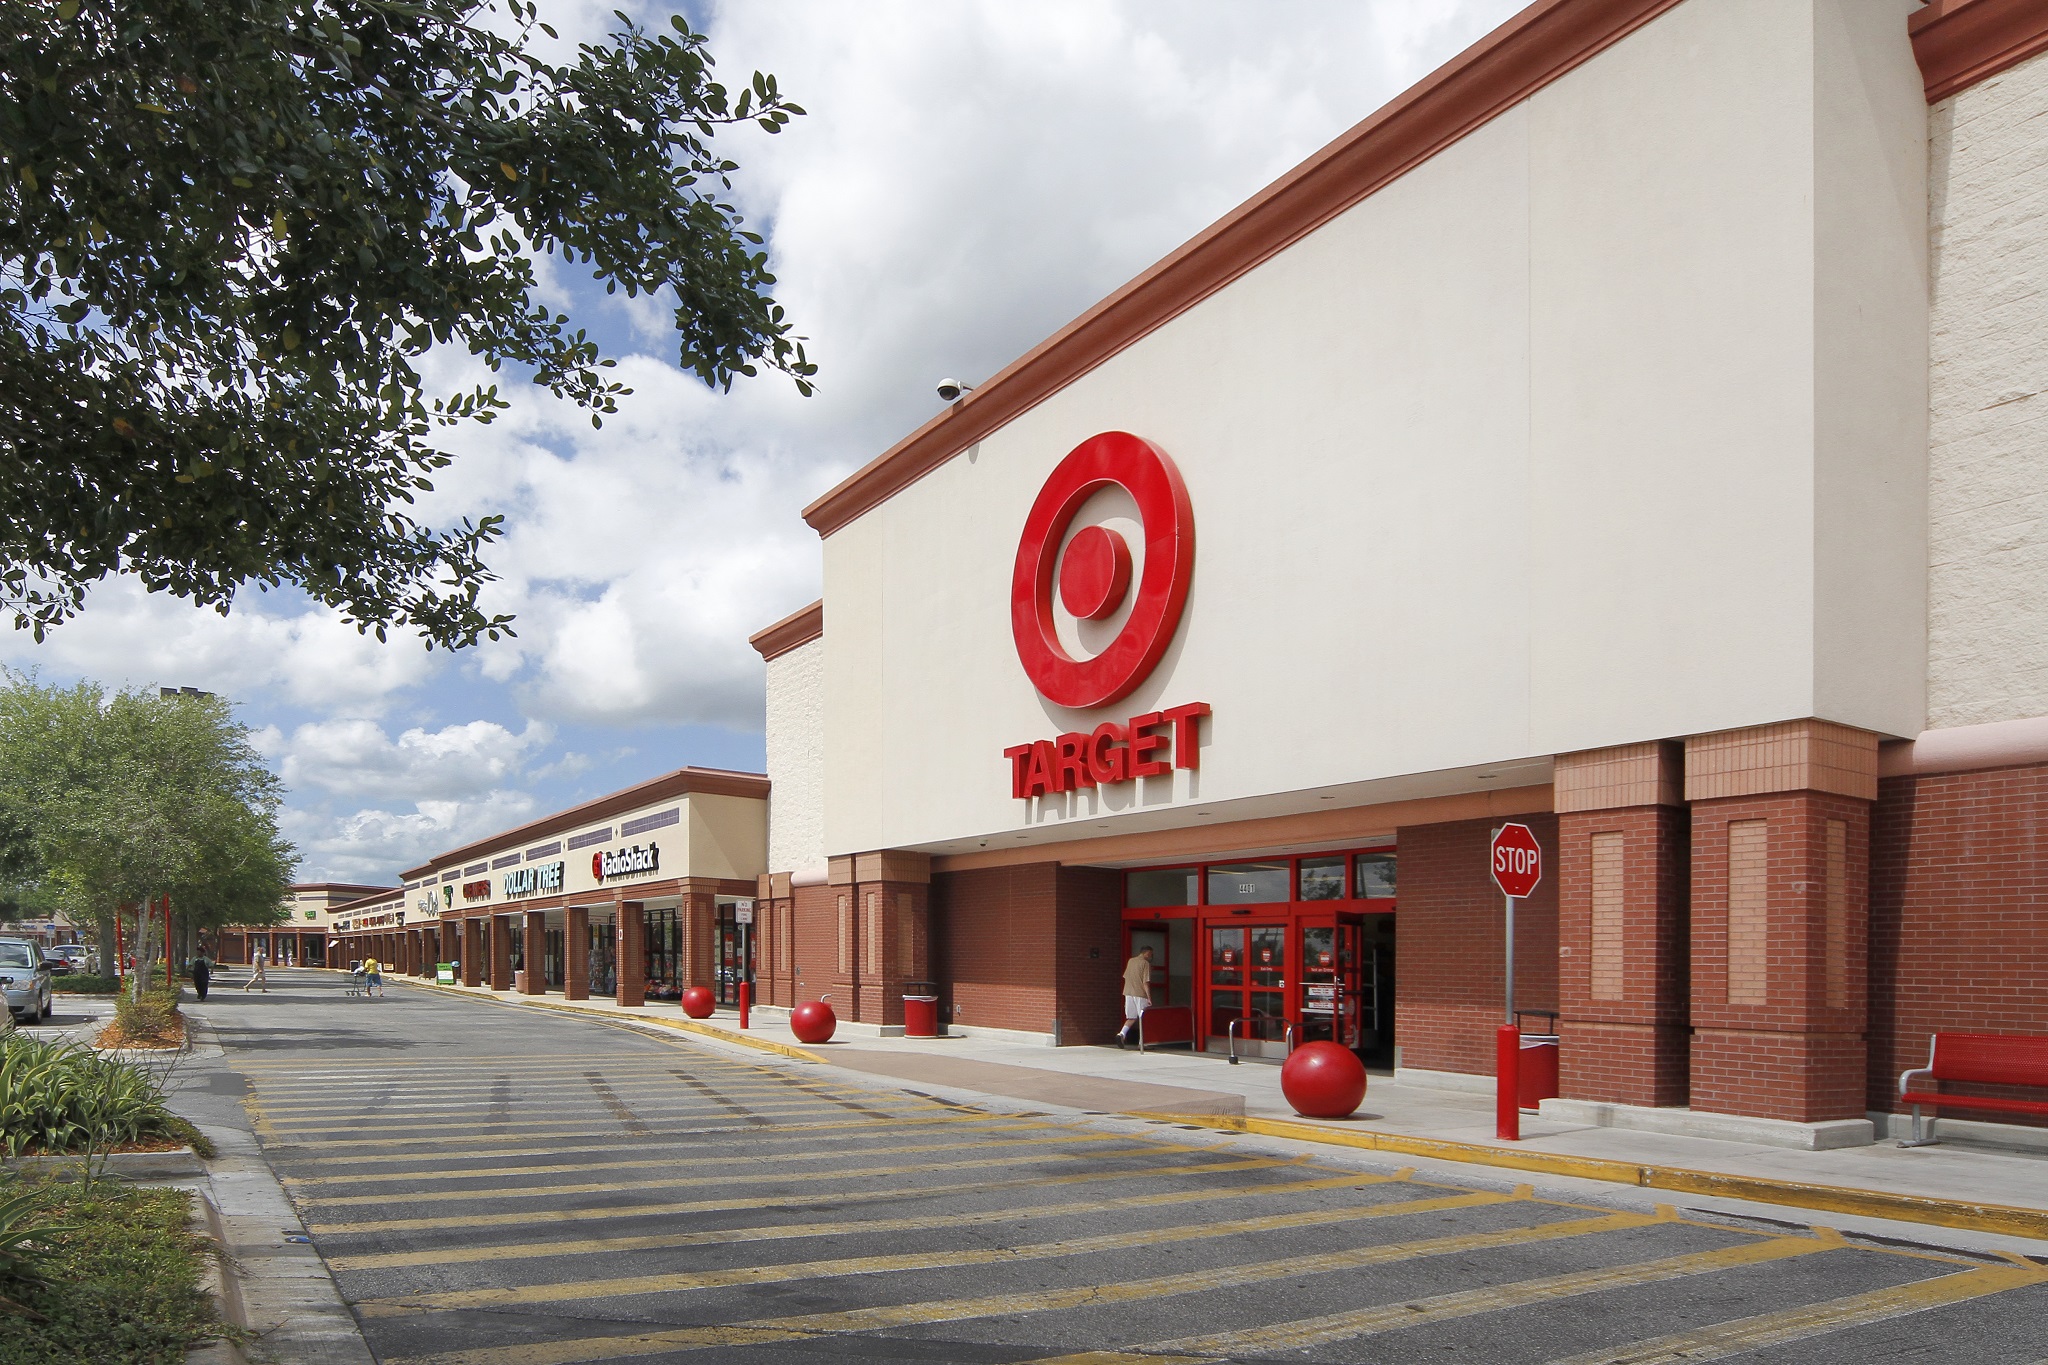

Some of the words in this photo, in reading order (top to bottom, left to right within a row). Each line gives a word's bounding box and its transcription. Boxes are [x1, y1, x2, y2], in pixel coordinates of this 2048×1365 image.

[1003, 701, 1211, 800] TARGET
[602, 842, 655, 876] RadioShack
[1495, 845, 1538, 875] STOP
[503, 867, 535, 895] DOLLAR
[537, 860, 562, 889] TREE
